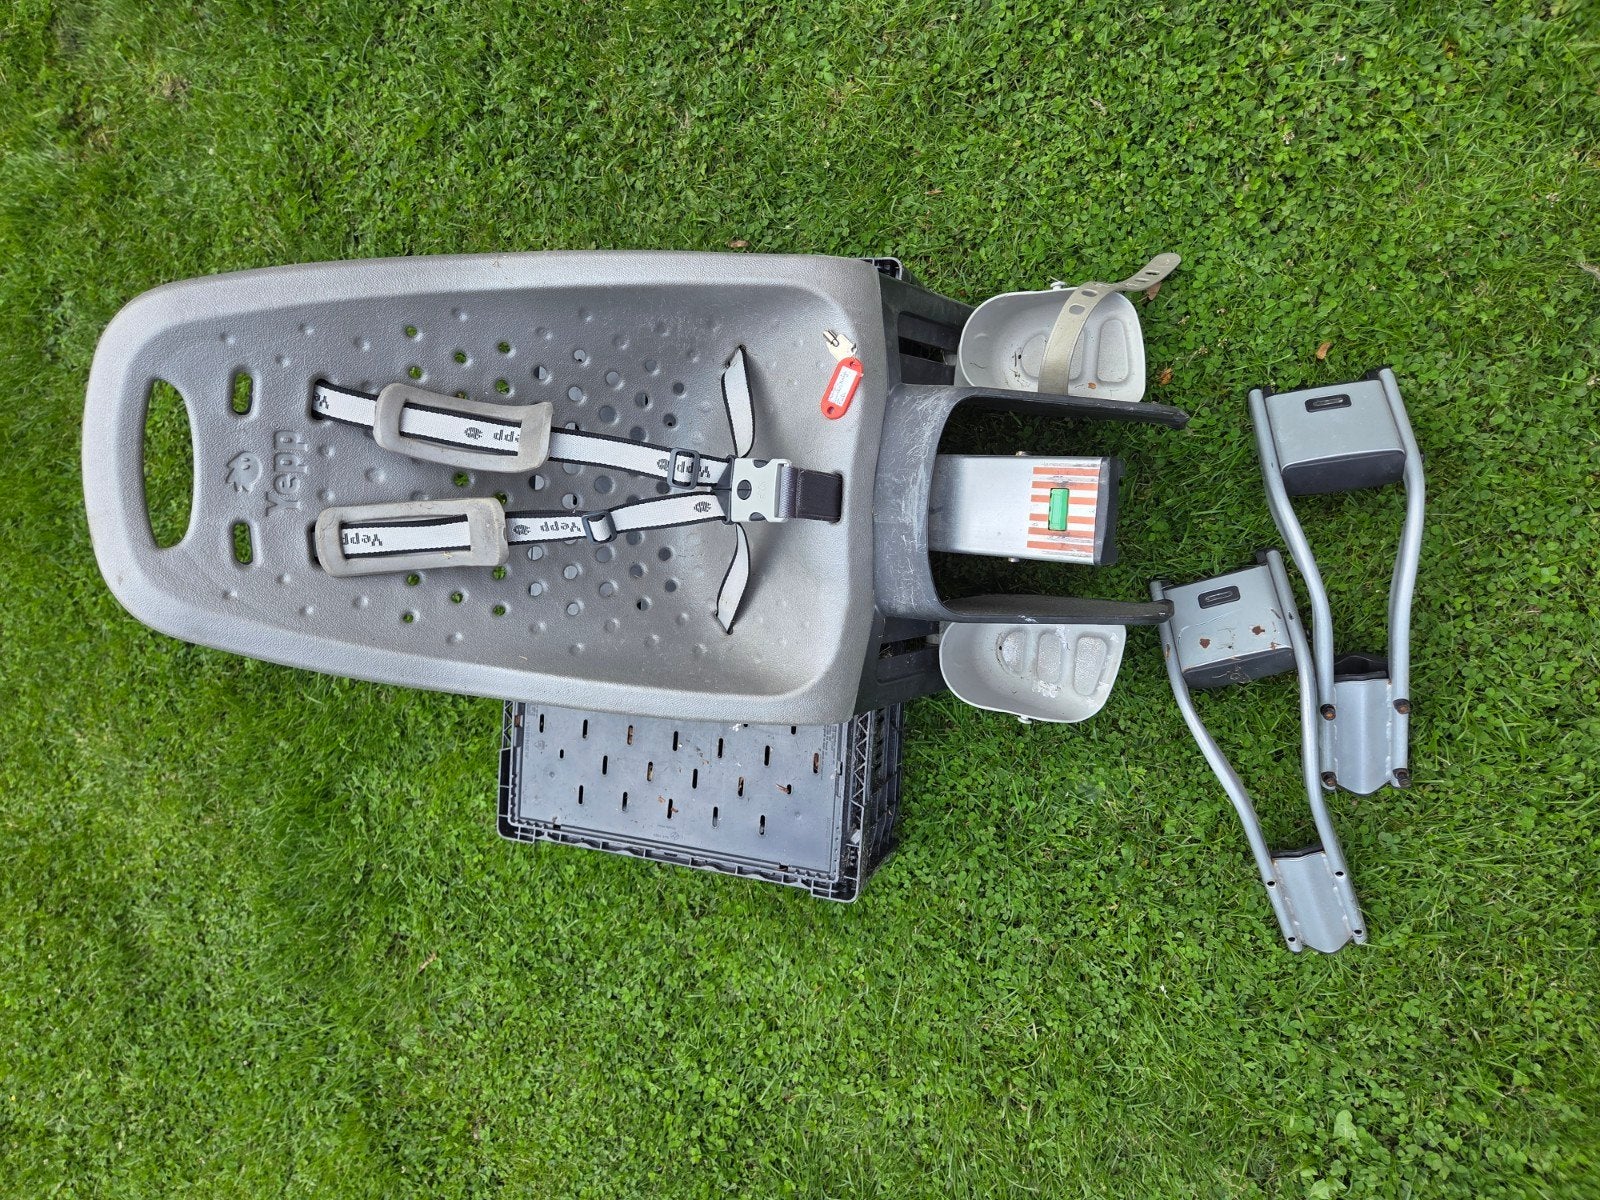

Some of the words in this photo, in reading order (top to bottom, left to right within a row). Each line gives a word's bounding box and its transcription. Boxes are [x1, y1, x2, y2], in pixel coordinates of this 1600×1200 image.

[264, 430, 308, 517] Yepp
[676, 461, 711, 479] Ypp
[540, 520, 582, 533] Yepp
